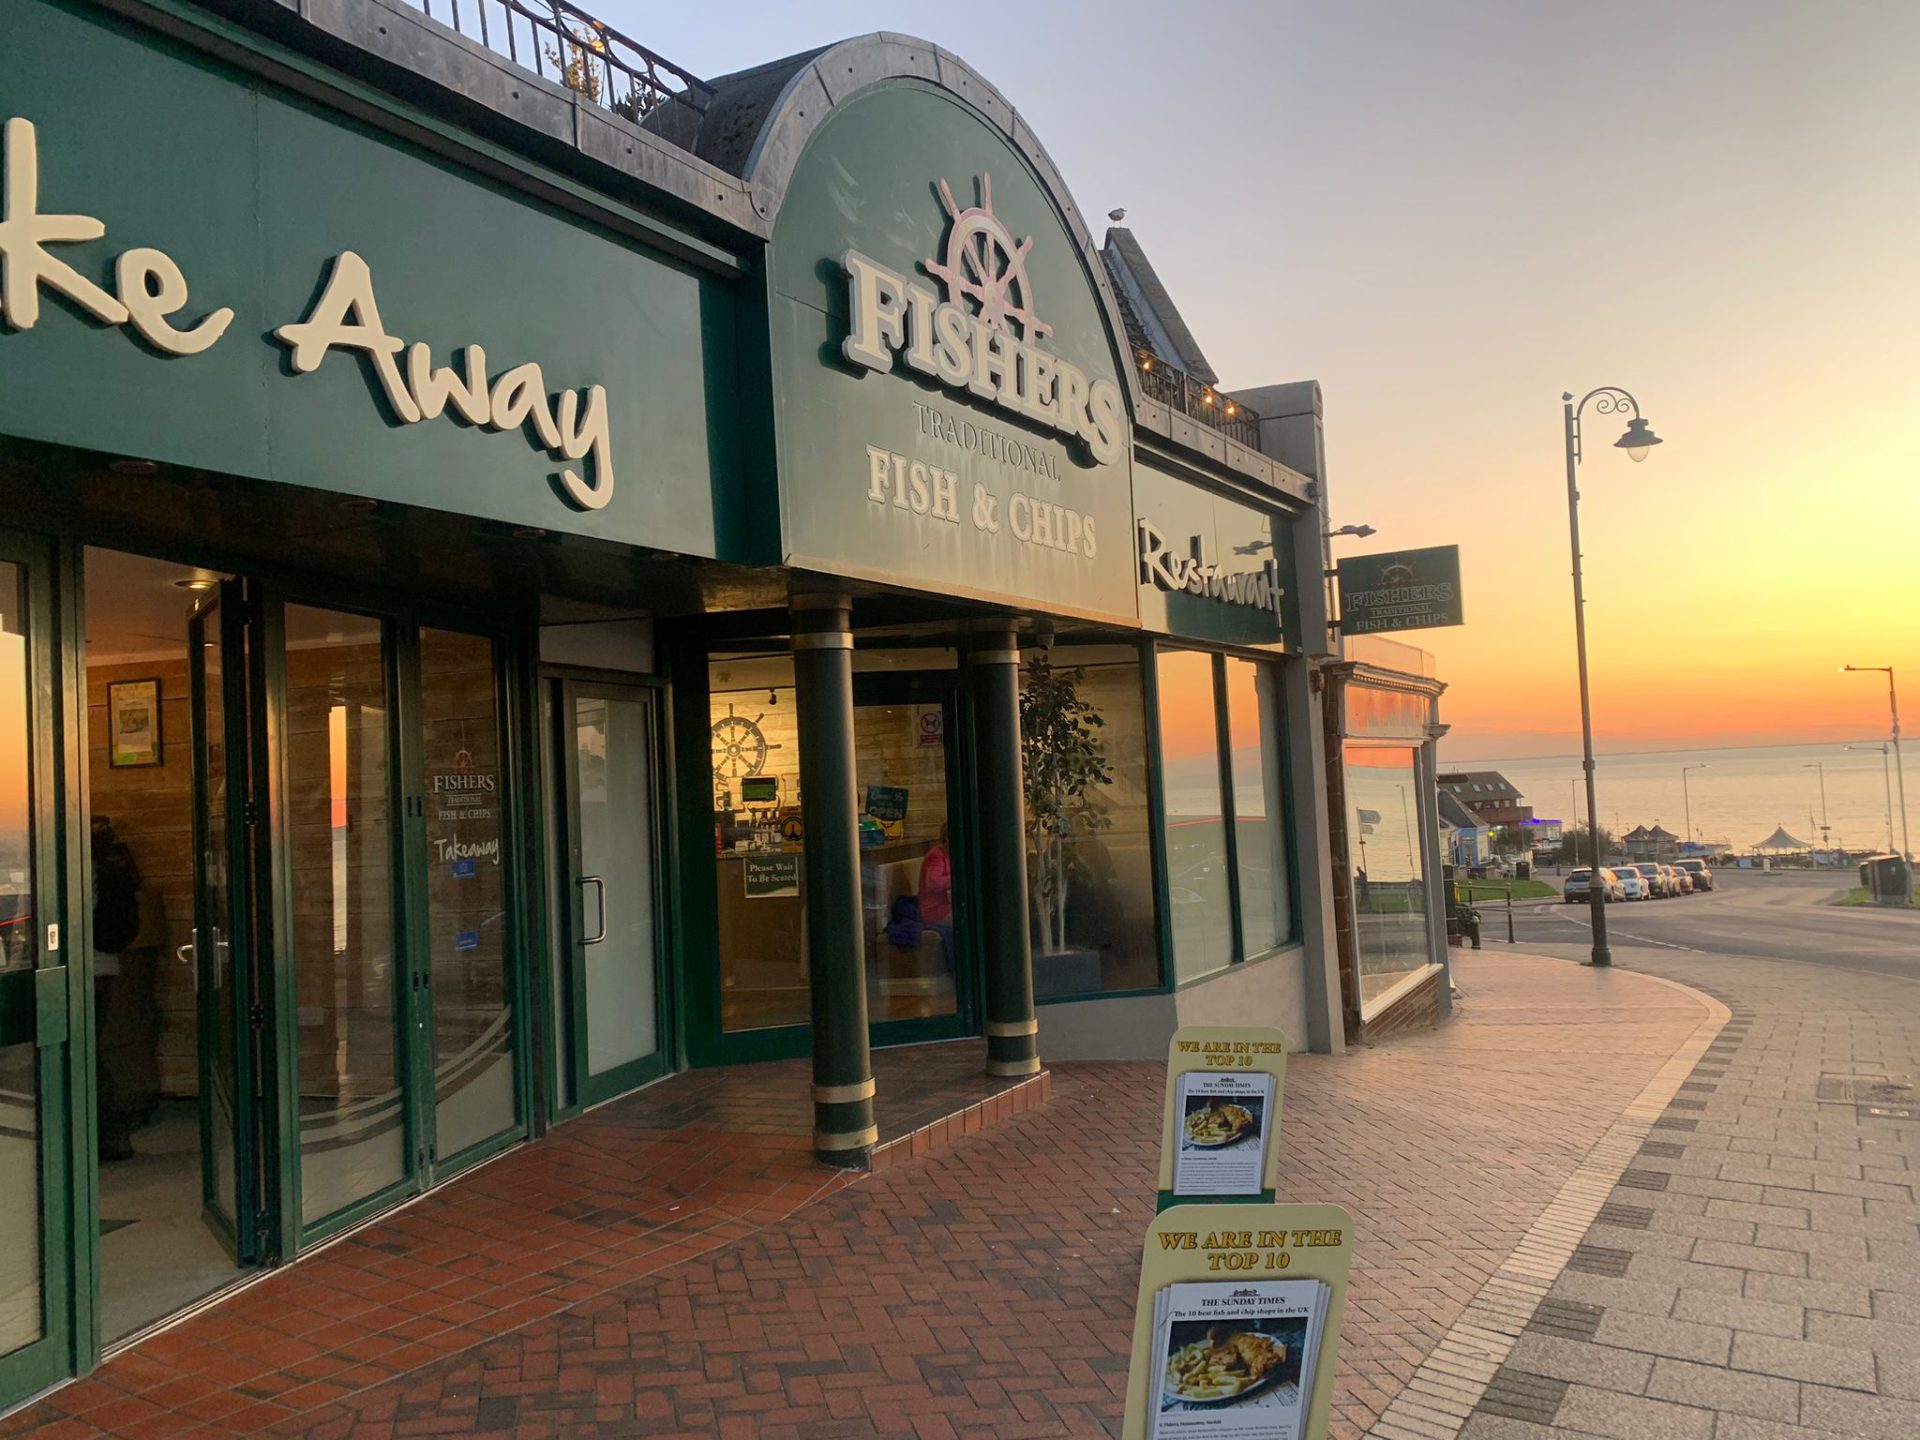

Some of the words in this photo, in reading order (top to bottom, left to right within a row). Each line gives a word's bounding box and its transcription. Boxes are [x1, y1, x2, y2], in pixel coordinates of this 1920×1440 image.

[842, 249, 1128, 466] FISHERS
[275, 251, 614, 510] Away
[912, 401, 1062, 482] TRADITIONAL
[866, 444, 960, 526] FISH
[972, 482, 999, 534] &
[1008, 491, 1097, 559] CHIPS
[1139, 518, 1285, 616] Restaurant
[1345, 582, 1455, 613] FISHERS
[1371, 603, 1433, 616] TRADITIONAL
[1356, 619, 1388, 632] FISH
[1391, 617, 1401, 629] &
[1405, 612, 1449, 627] CHIPS
[433, 774, 495, 794] FISHERS
[439, 810, 457, 820] FISH
[468, 808, 491, 819] CHIPS
[869, 806, 904, 819] OPEN
[434, 833, 499, 865] Takeaway
[750, 864, 775, 872] Please
[776, 862, 793, 871] Wait
[747, 875, 758, 883] To
[1178, 1041, 1199, 1053] WE
[1202, 1042, 1230, 1053] ARE
[1233, 1042, 1249, 1054] IN
[1252, 1043, 1281, 1055] THE
[1206, 1055, 1235, 1067] TOP
[1238, 1055, 1253, 1067] 10
[1158, 1232, 1198, 1250] WE
[1201, 1231, 1253, 1249] ARE
[1257, 1231, 1287, 1248] IN
[1291, 1229, 1342, 1247] THE
[1208, 1252, 1259, 1270] TOP
[1265, 1252, 1290, 1269] 10
[1221, 1298, 1255, 1306] SUNDAY
[1258, 1297, 1285, 1305] TIMES
[1241, 1308, 1255, 1316] chip
[1257, 1308, 1275, 1316] shops
